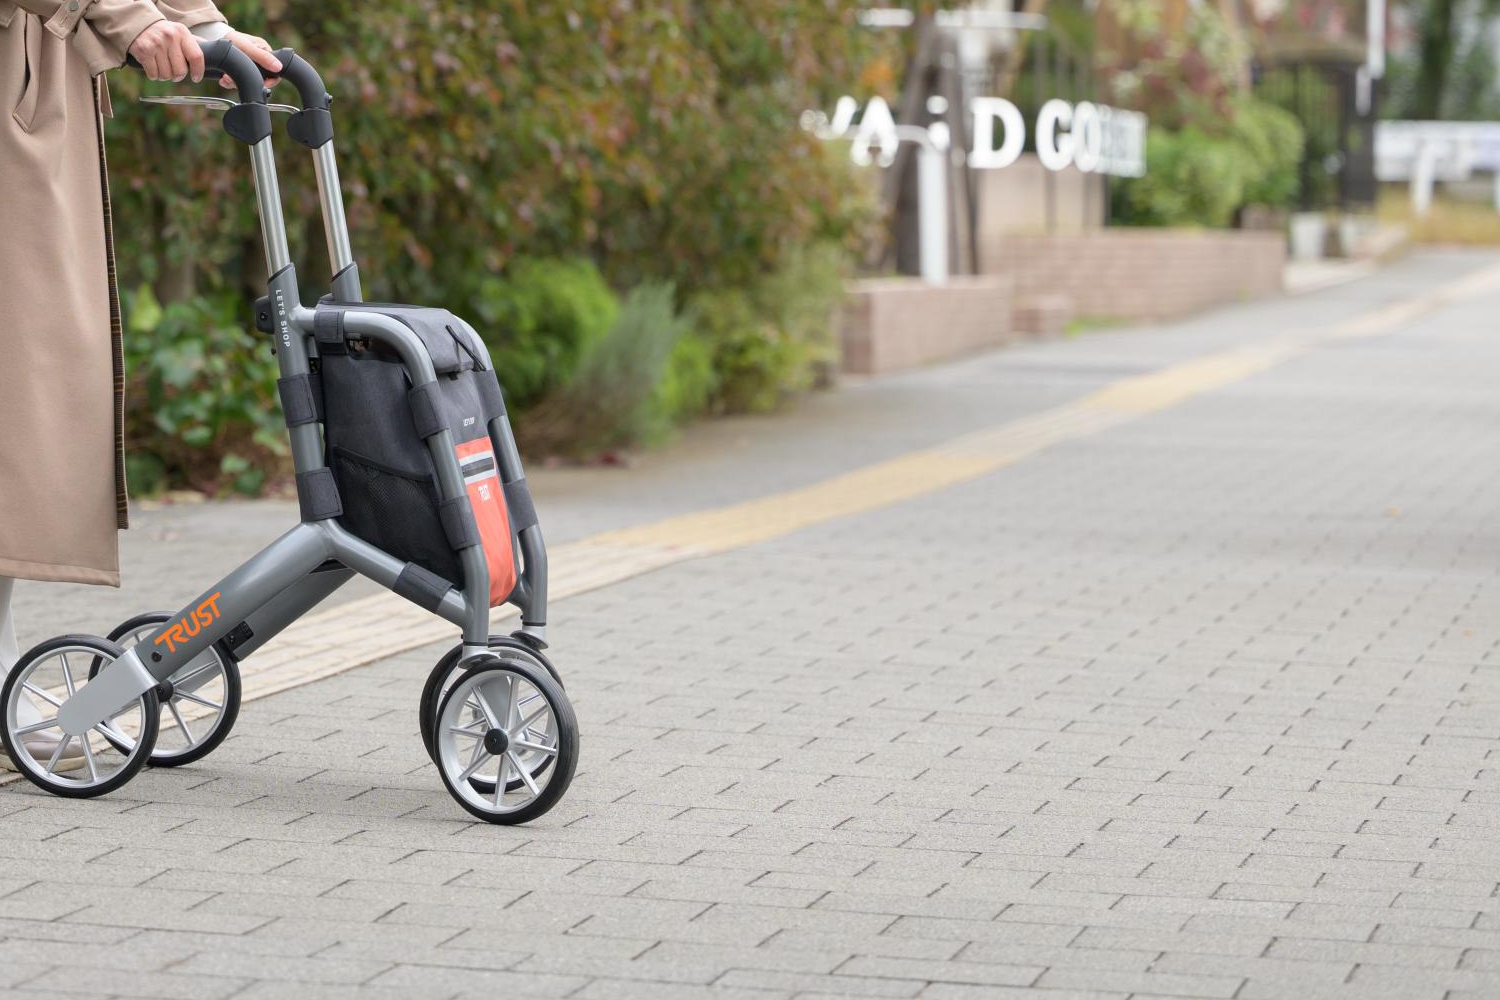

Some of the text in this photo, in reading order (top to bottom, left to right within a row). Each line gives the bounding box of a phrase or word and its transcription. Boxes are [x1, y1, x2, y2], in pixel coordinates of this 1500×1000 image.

[275, 289, 291, 347] LET'S SHOP
[153, 591, 221, 654] TRUST
